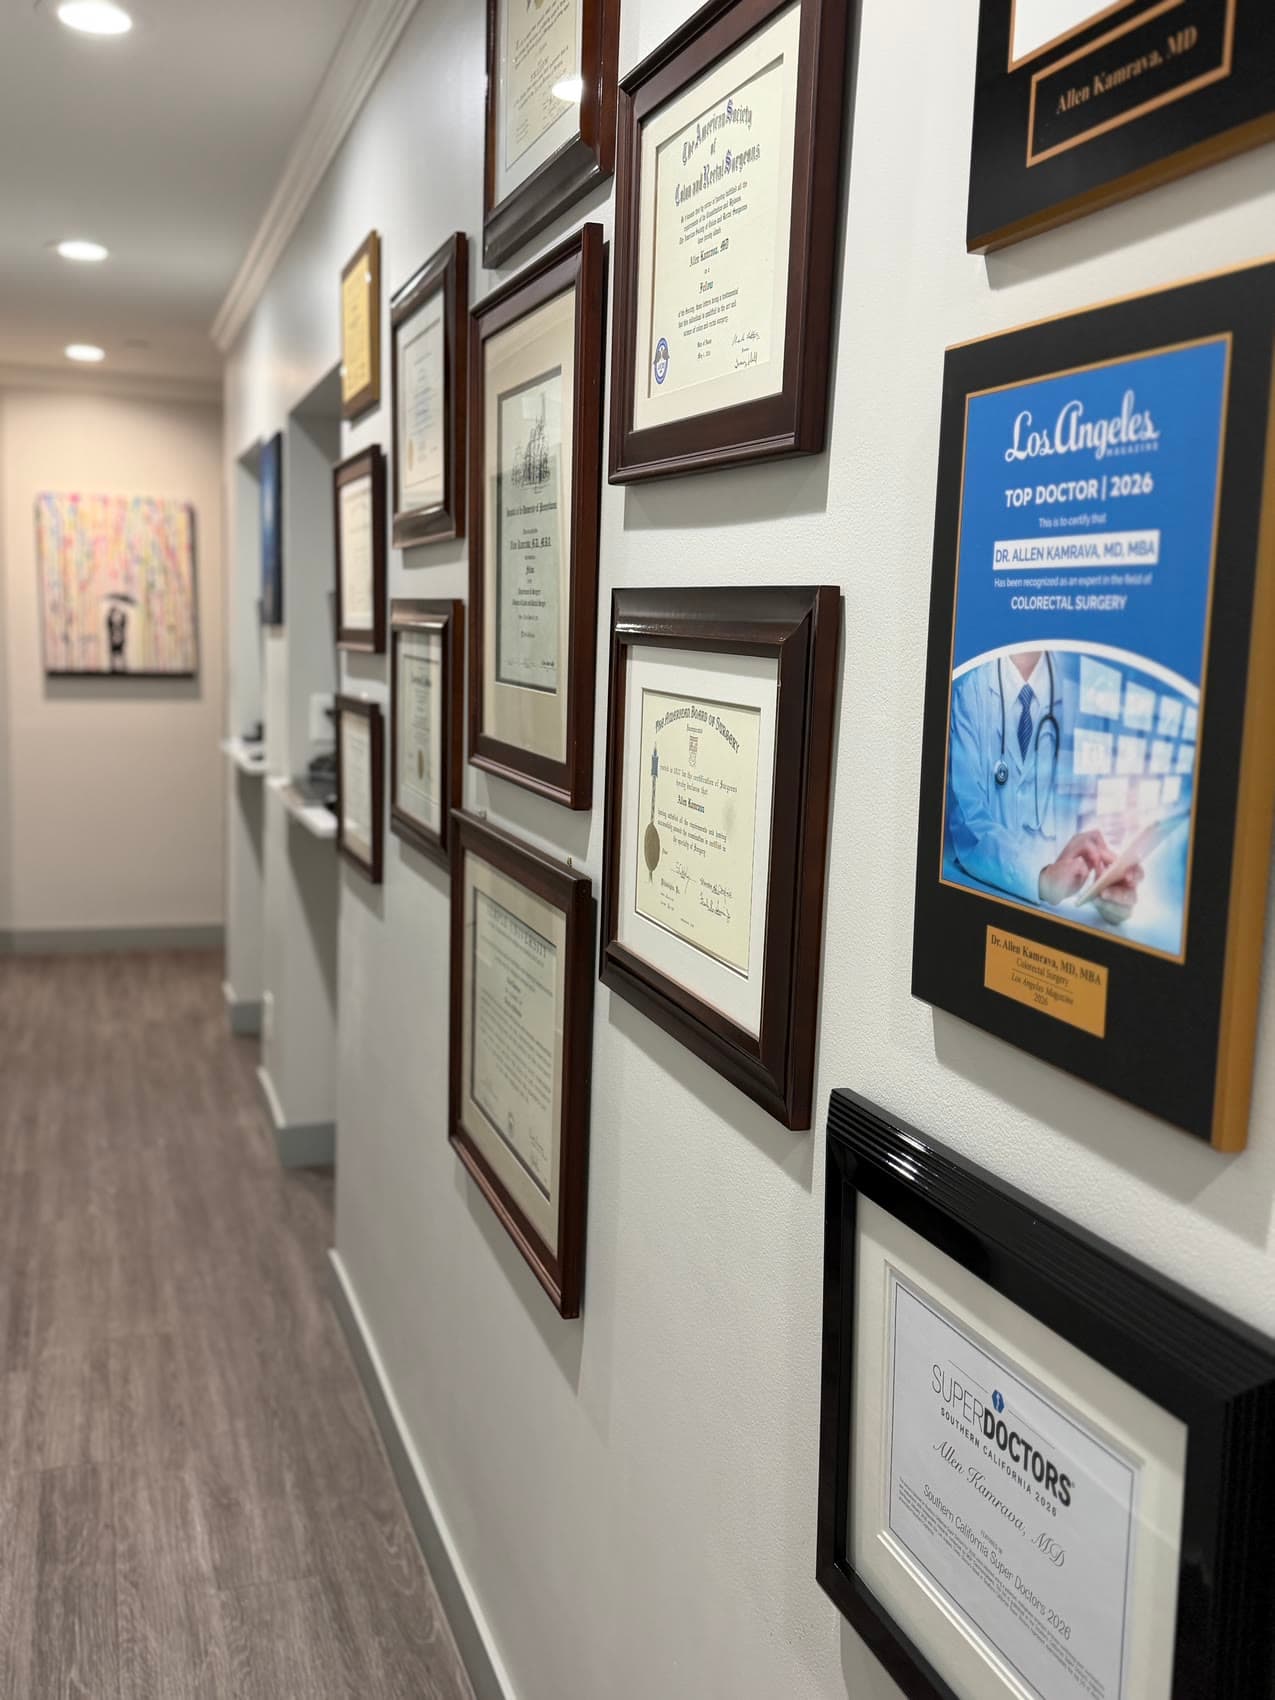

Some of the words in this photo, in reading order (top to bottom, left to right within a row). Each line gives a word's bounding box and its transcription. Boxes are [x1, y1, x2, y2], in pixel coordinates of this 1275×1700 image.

[1056, 86, 1089, 114] Allen
[1093, 50, 1163, 96] Kamrava,
[1166, 25, 1198, 58] MD
[1005, 411, 1056, 463] Los
[1054, 389, 1160, 460] Angeles
[1005, 488, 1032, 508] TOP
[1036, 479, 1098, 504] DOCTOR
[1110, 472, 1154, 497] 2026
[1039, 517, 1051, 528] This
[1065, 514, 1090, 529] certify
[1091, 513, 1106, 524] that
[995, 549, 1010, 564] DR.
[1012, 546, 1044, 562] ALLEN
[1046, 543, 1100, 560] KAMRAVA,
[1104, 541, 1123, 558] MD,
[1128, 540, 1155, 556] MBA
[994, 578, 1006, 588] Has
[1007, 577, 1023, 587] been
[1024, 576, 1059, 589] recognized
[1011, 595, 1073, 610] COLORECTAL
[1075, 594, 1128, 611] SURGERY
[991, 934, 1001, 947] Dr.
[1002, 940, 1020, 953] Allen
[1022, 946, 1058, 970] Kamrava,
[1080, 968, 1101, 985] MBA
[1016, 958, 1045, 977] Colorectal
[941, 1407, 980, 1449] SOUTHERN
[983, 1445, 1032, 1495] CALIFORNIA
[1035, 1491, 1057, 1518] 2026
[933, 1440, 964, 1474] Allen
[1032, 1532, 1065, 1567] MD
[923, 1484, 953, 1523] Southern
[955, 1516, 988, 1557] California
[990, 1551, 1013, 1580] Super
[1014, 1575, 1046, 1616] Doctors
[1048, 1608, 1071, 1641] 2026
